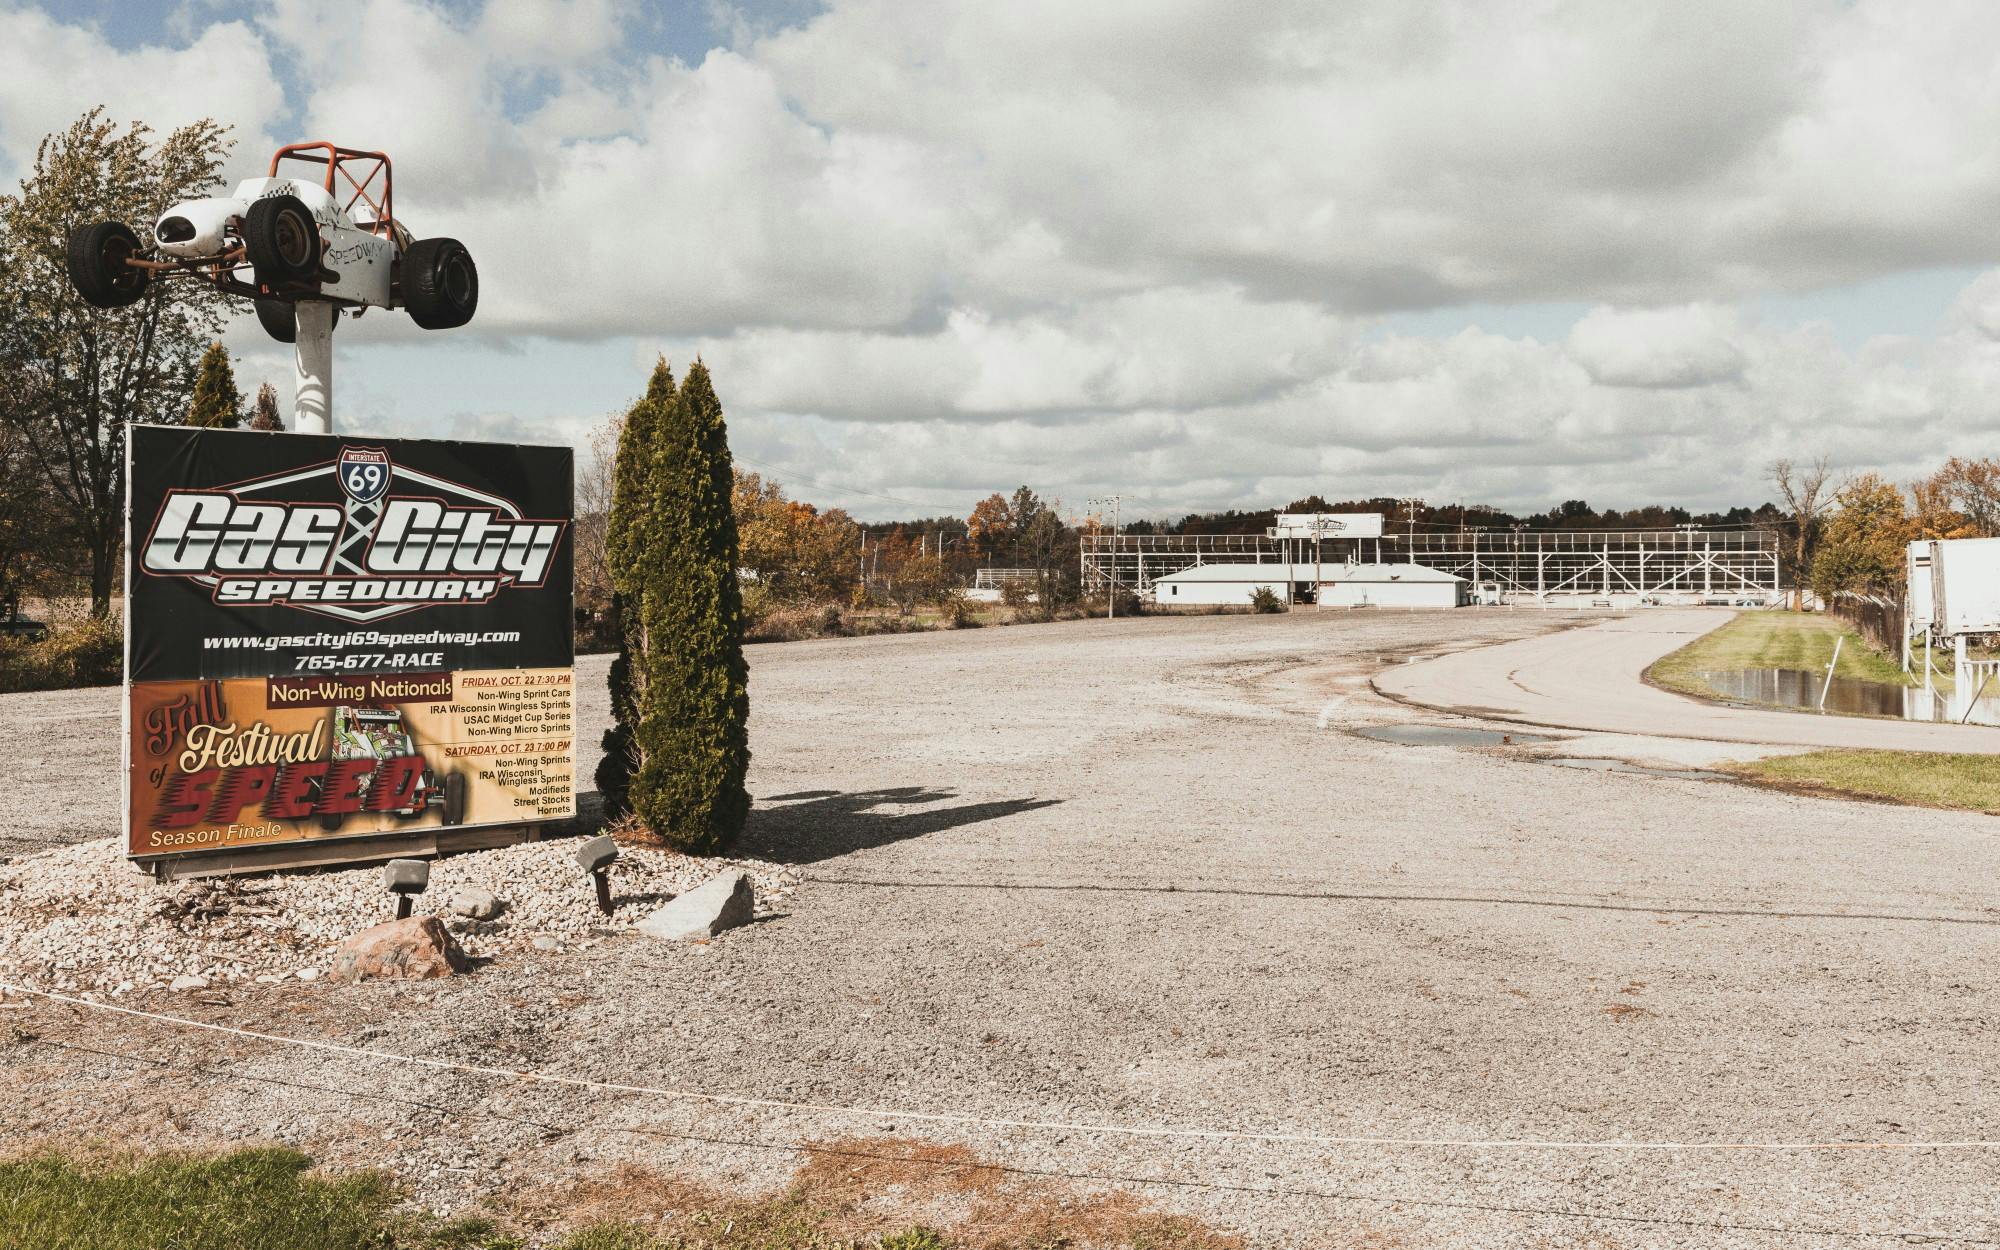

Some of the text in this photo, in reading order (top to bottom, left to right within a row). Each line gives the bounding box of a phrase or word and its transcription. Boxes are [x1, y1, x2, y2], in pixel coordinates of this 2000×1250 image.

[348, 454, 381, 462] INTERSTATE
[348, 465, 381, 492] 69
[143, 493, 559, 582] Gas City
[217, 580, 496, 600] SPEEDWAY
[203, 630, 521, 650] www.gascityi69speedway.com
[294, 652, 444, 671] 765-677-RACE
[461, 674, 571, 687] FRIDAY, OCT. 22 7:30 PM
[271, 678, 452, 702] Non-Wing Nationals
[477, 688, 571, 701] Non-Wing Sprint Cars
[430, 700, 571, 714] IRA Wisconsin Wingless Sprints
[144, 680, 227, 755] Fall
[463, 711, 571, 725] USAC Midget Cup Series
[468, 723, 571, 737] Non-Wing Micro Sprints
[179, 719, 325, 773] Festival
[444, 741, 571, 757] SATURDAY, OCT. 23 7:00 PM
[495, 755, 571, 768] Non-Wing Sprints
[150, 763, 168, 789] of
[479, 768, 543, 780] IRA Wisconsin
[498, 774, 571, 787] Wingless Sprints
[149, 756, 426, 828] SPEED
[529, 785, 571, 795] Modifieds
[513, 794, 571, 807] Street Stocks
[537, 804, 571, 815] Hornets
[149, 821, 282, 848] Season Finale
